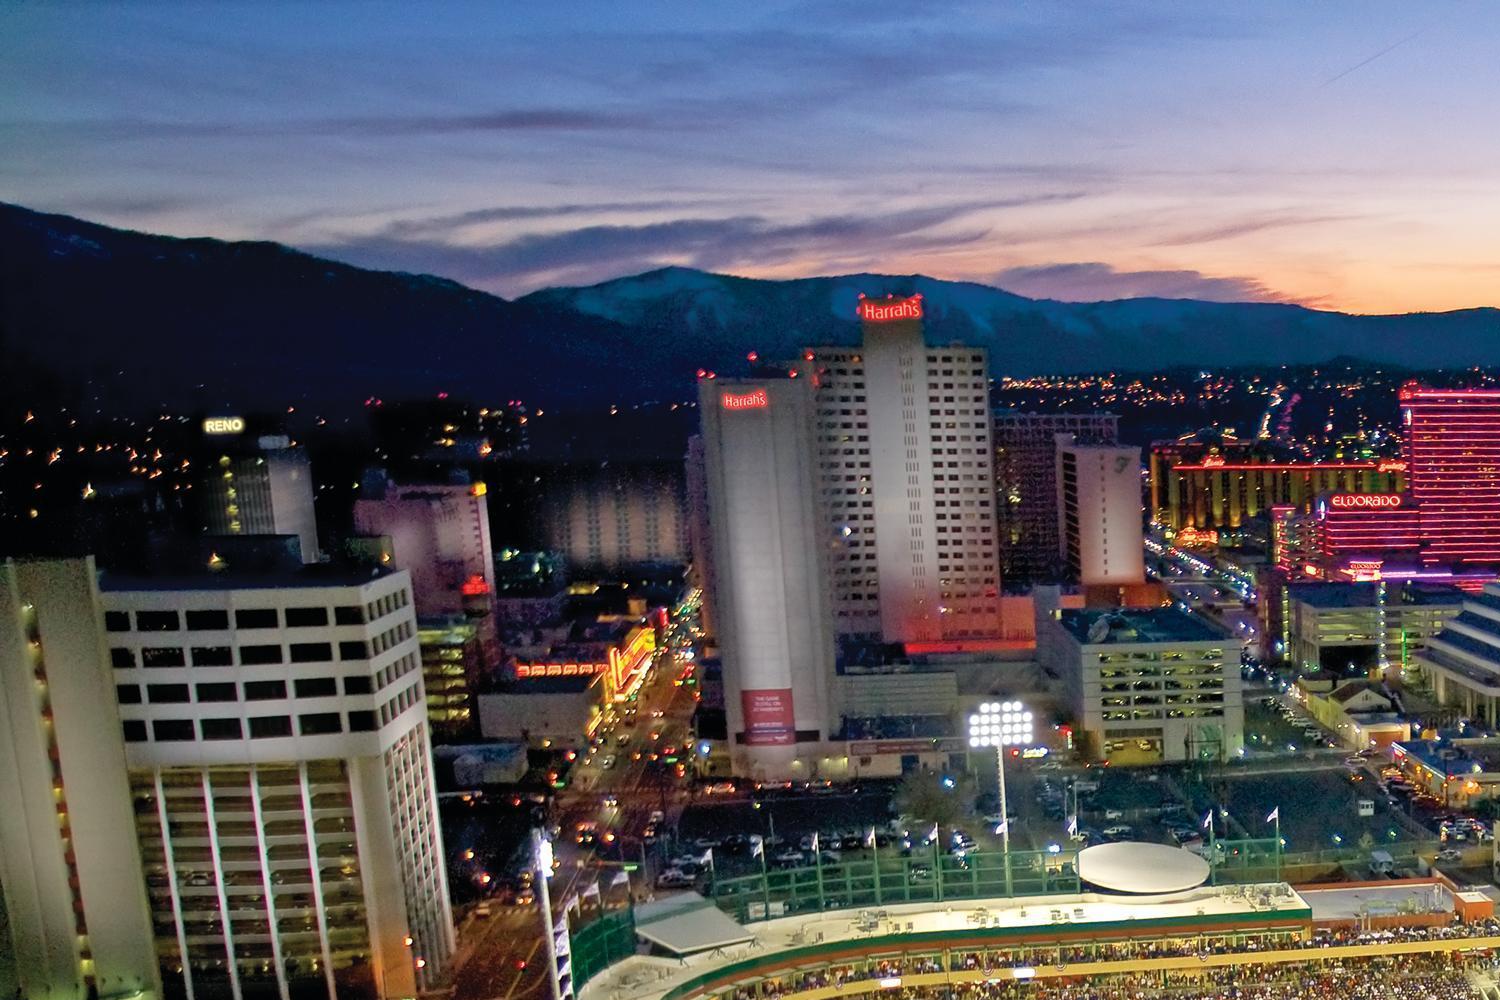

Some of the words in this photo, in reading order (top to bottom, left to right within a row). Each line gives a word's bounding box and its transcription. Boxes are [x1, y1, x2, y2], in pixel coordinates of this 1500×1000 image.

[864, 300, 921, 320] Harrah's
[724, 392, 766, 408] Harrah's
[205, 419, 243, 432] RENO
[1332, 496, 1401, 508] ELDORADO
